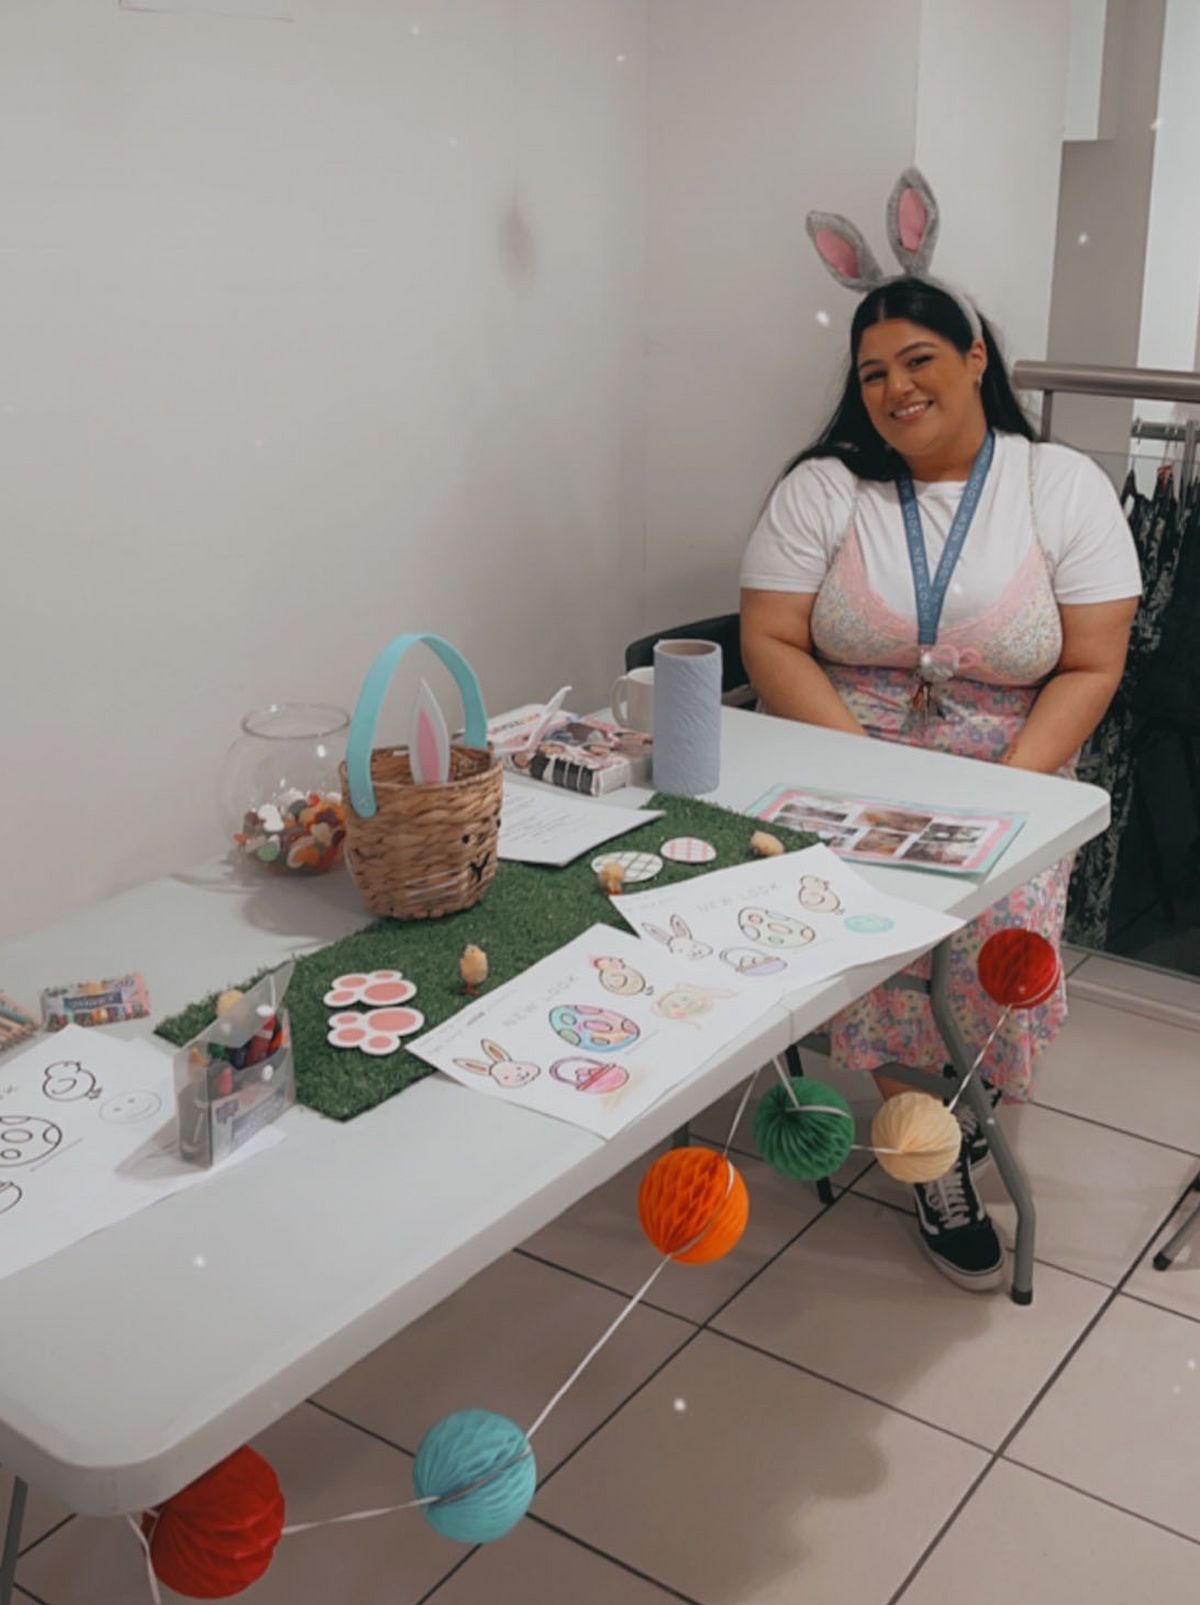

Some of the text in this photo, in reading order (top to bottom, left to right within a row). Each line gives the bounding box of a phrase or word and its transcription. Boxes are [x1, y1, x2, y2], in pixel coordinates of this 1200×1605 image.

[905, 503, 930, 621] LOOK NEW LOOK
[936, 549, 955, 587] LOOK
[951, 511, 968, 542] NEW
[965, 471, 983, 507] LOOK
